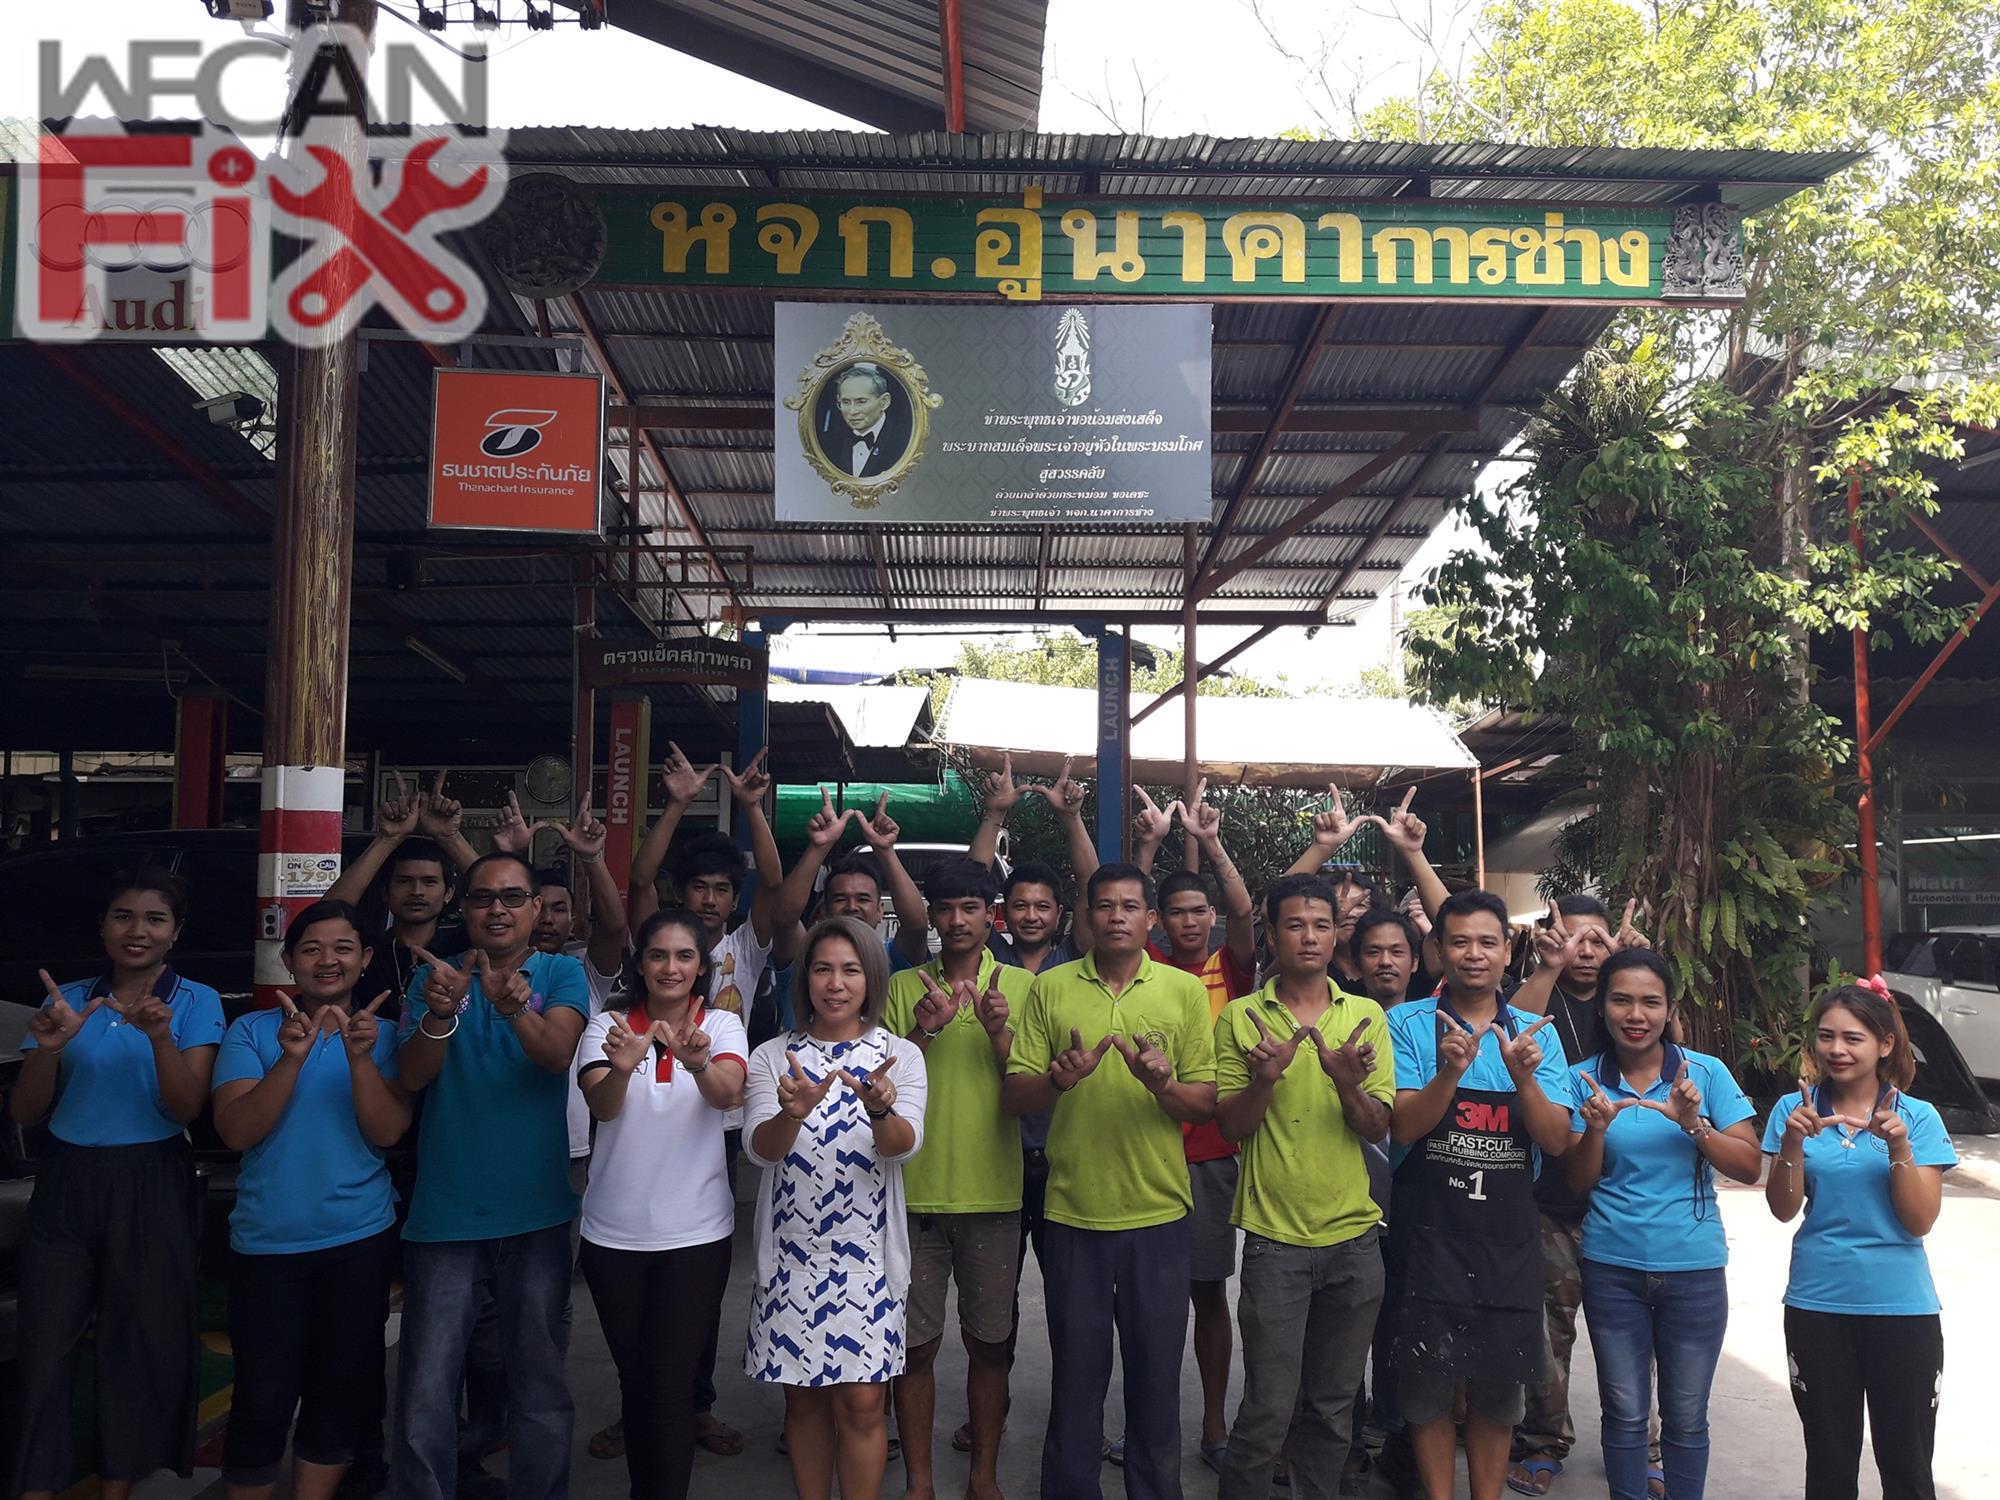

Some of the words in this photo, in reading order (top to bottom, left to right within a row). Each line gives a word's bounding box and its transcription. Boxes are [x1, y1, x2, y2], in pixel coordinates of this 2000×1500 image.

[65, 279, 206, 331] Audi
[442, 463, 591, 482] ธนชาตประกันภัย
[458, 482, 518, 493] Thanachart
[521, 485, 575, 495] Insurance
[603, 643, 752, 671] ตรวจเช็คสภาพรถ
[1104, 658, 1121, 740] LAUNCH
[611, 727, 631, 824] LAUNCH
[287, 871, 336, 882] 1790
[1455, 1101, 1509, 1132] 3M
[1429, 1142, 1451, 1152] PASTE
[1452, 1146, 1489, 1158] RUBBING
[1490, 1150, 1526, 1159] COMPOUND
[1450, 1134, 1511, 1151] FAST-CUT
[1449, 1177, 1468, 1189] No.
[1468, 1170, 1487, 1200] 1
